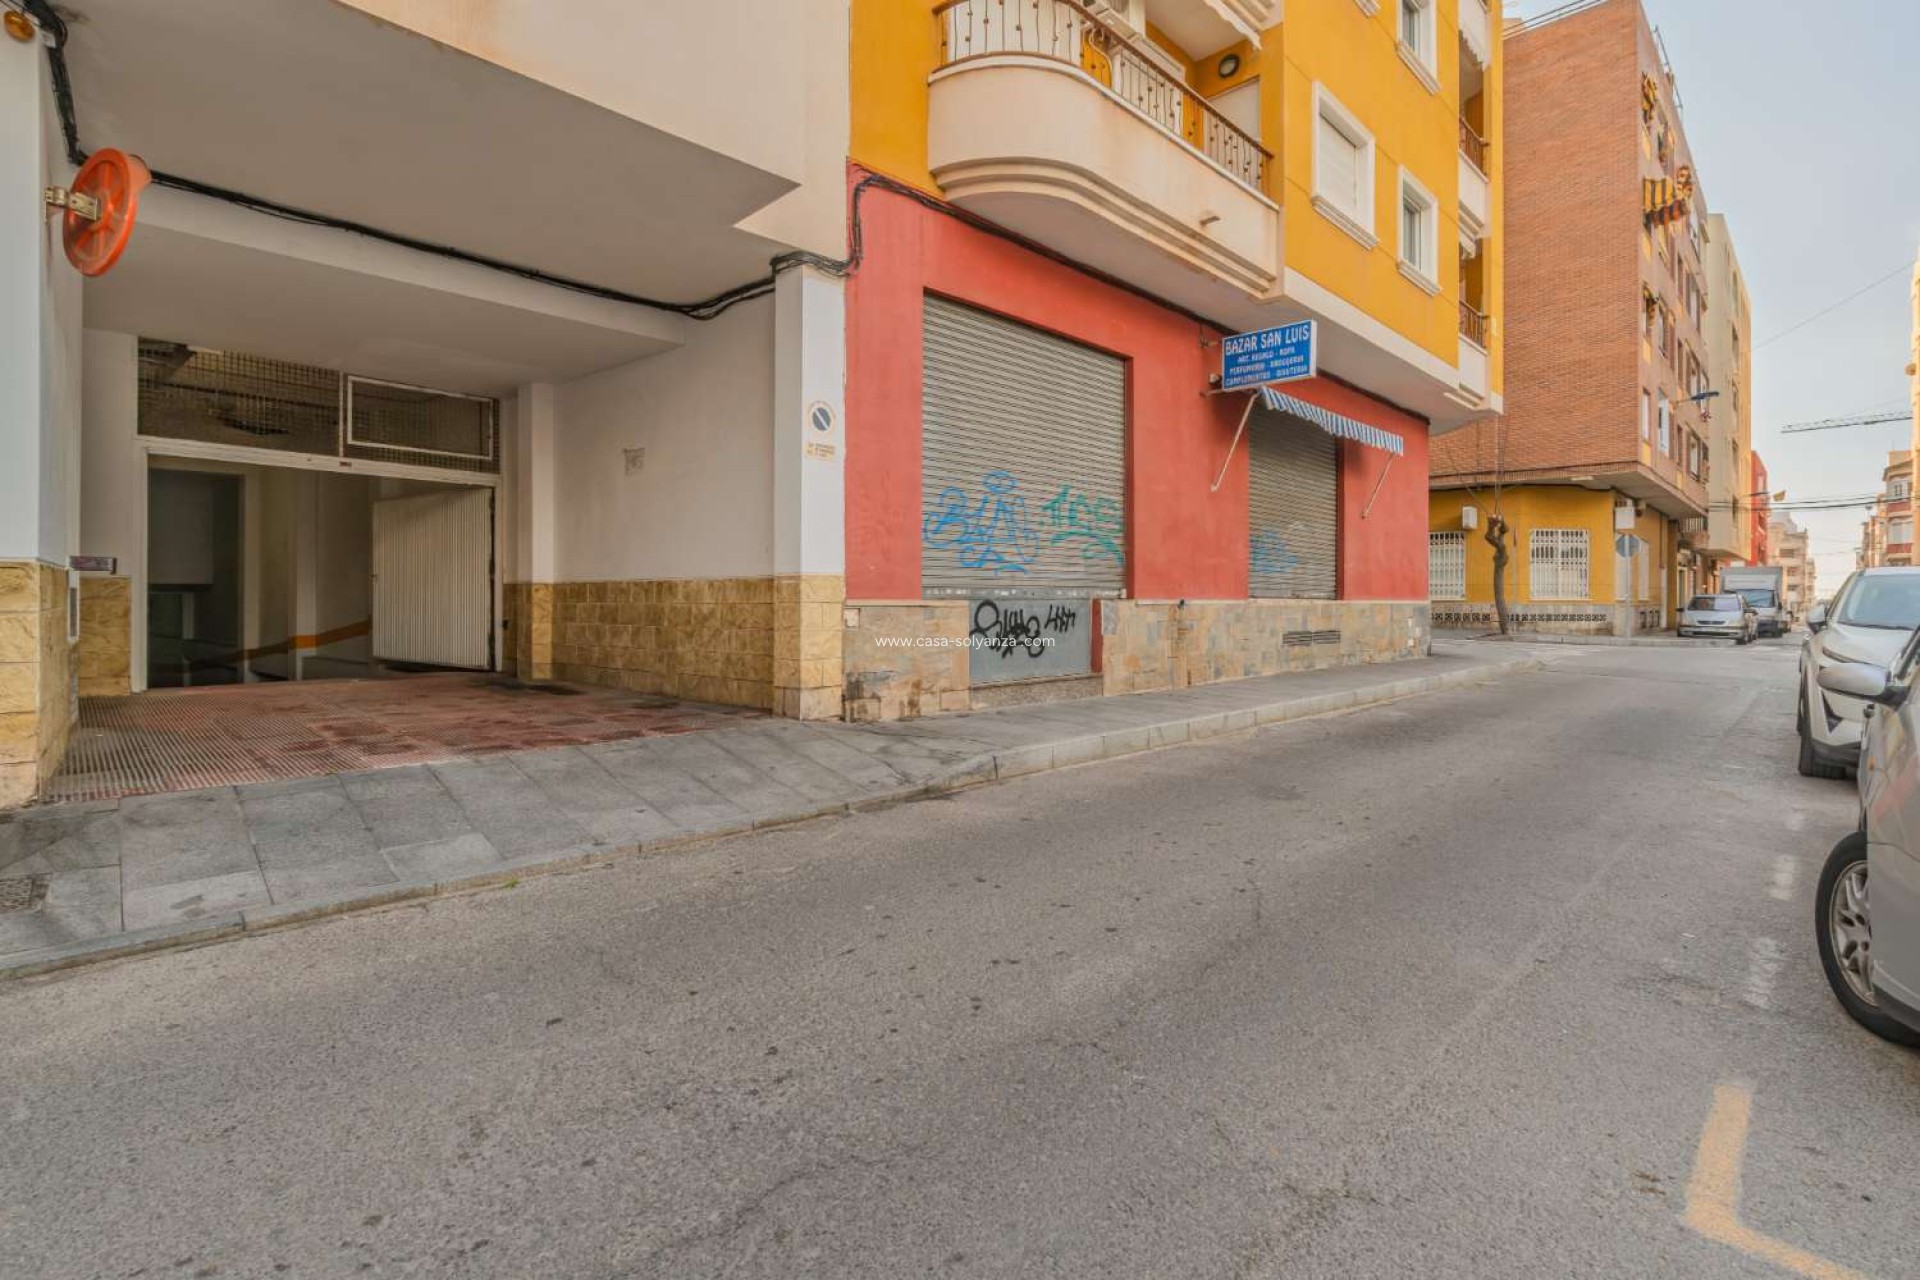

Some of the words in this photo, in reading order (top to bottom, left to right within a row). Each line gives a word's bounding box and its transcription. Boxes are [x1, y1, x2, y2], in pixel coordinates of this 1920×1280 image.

[1225, 336, 1258, 356] BAZAR
[1261, 330, 1281, 349] SAN
[1285, 325, 1309, 344] LUIS
